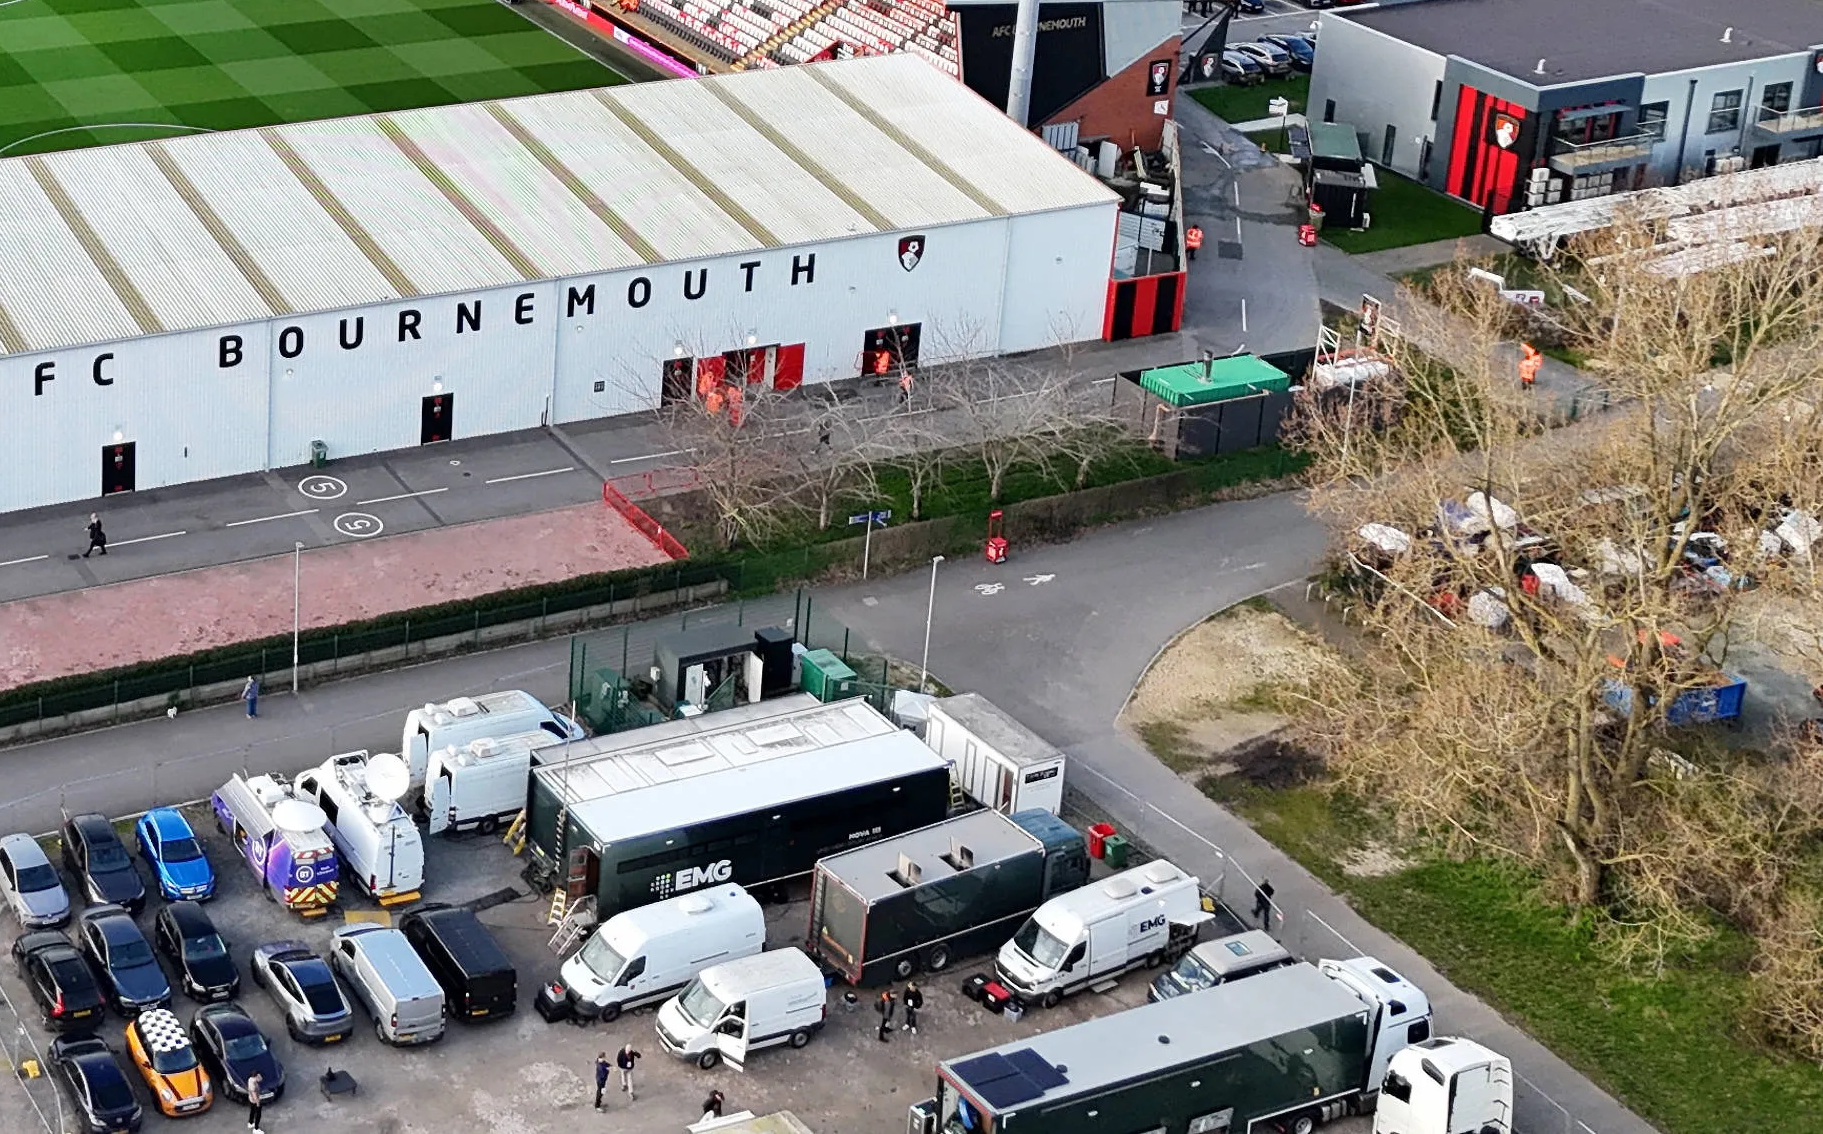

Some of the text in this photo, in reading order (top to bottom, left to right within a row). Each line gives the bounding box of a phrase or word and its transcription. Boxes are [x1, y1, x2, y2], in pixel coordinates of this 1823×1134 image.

[992, 26, 1011, 38] AFC
[218, 253, 816, 368] BOURNEMOUTH
[310, 482, 336, 493] 5
[345, 519, 371, 530] 5
[299, 870, 309, 878] BT
[675, 859, 732, 891] EMG
[1140, 914, 1166, 933] EMG
